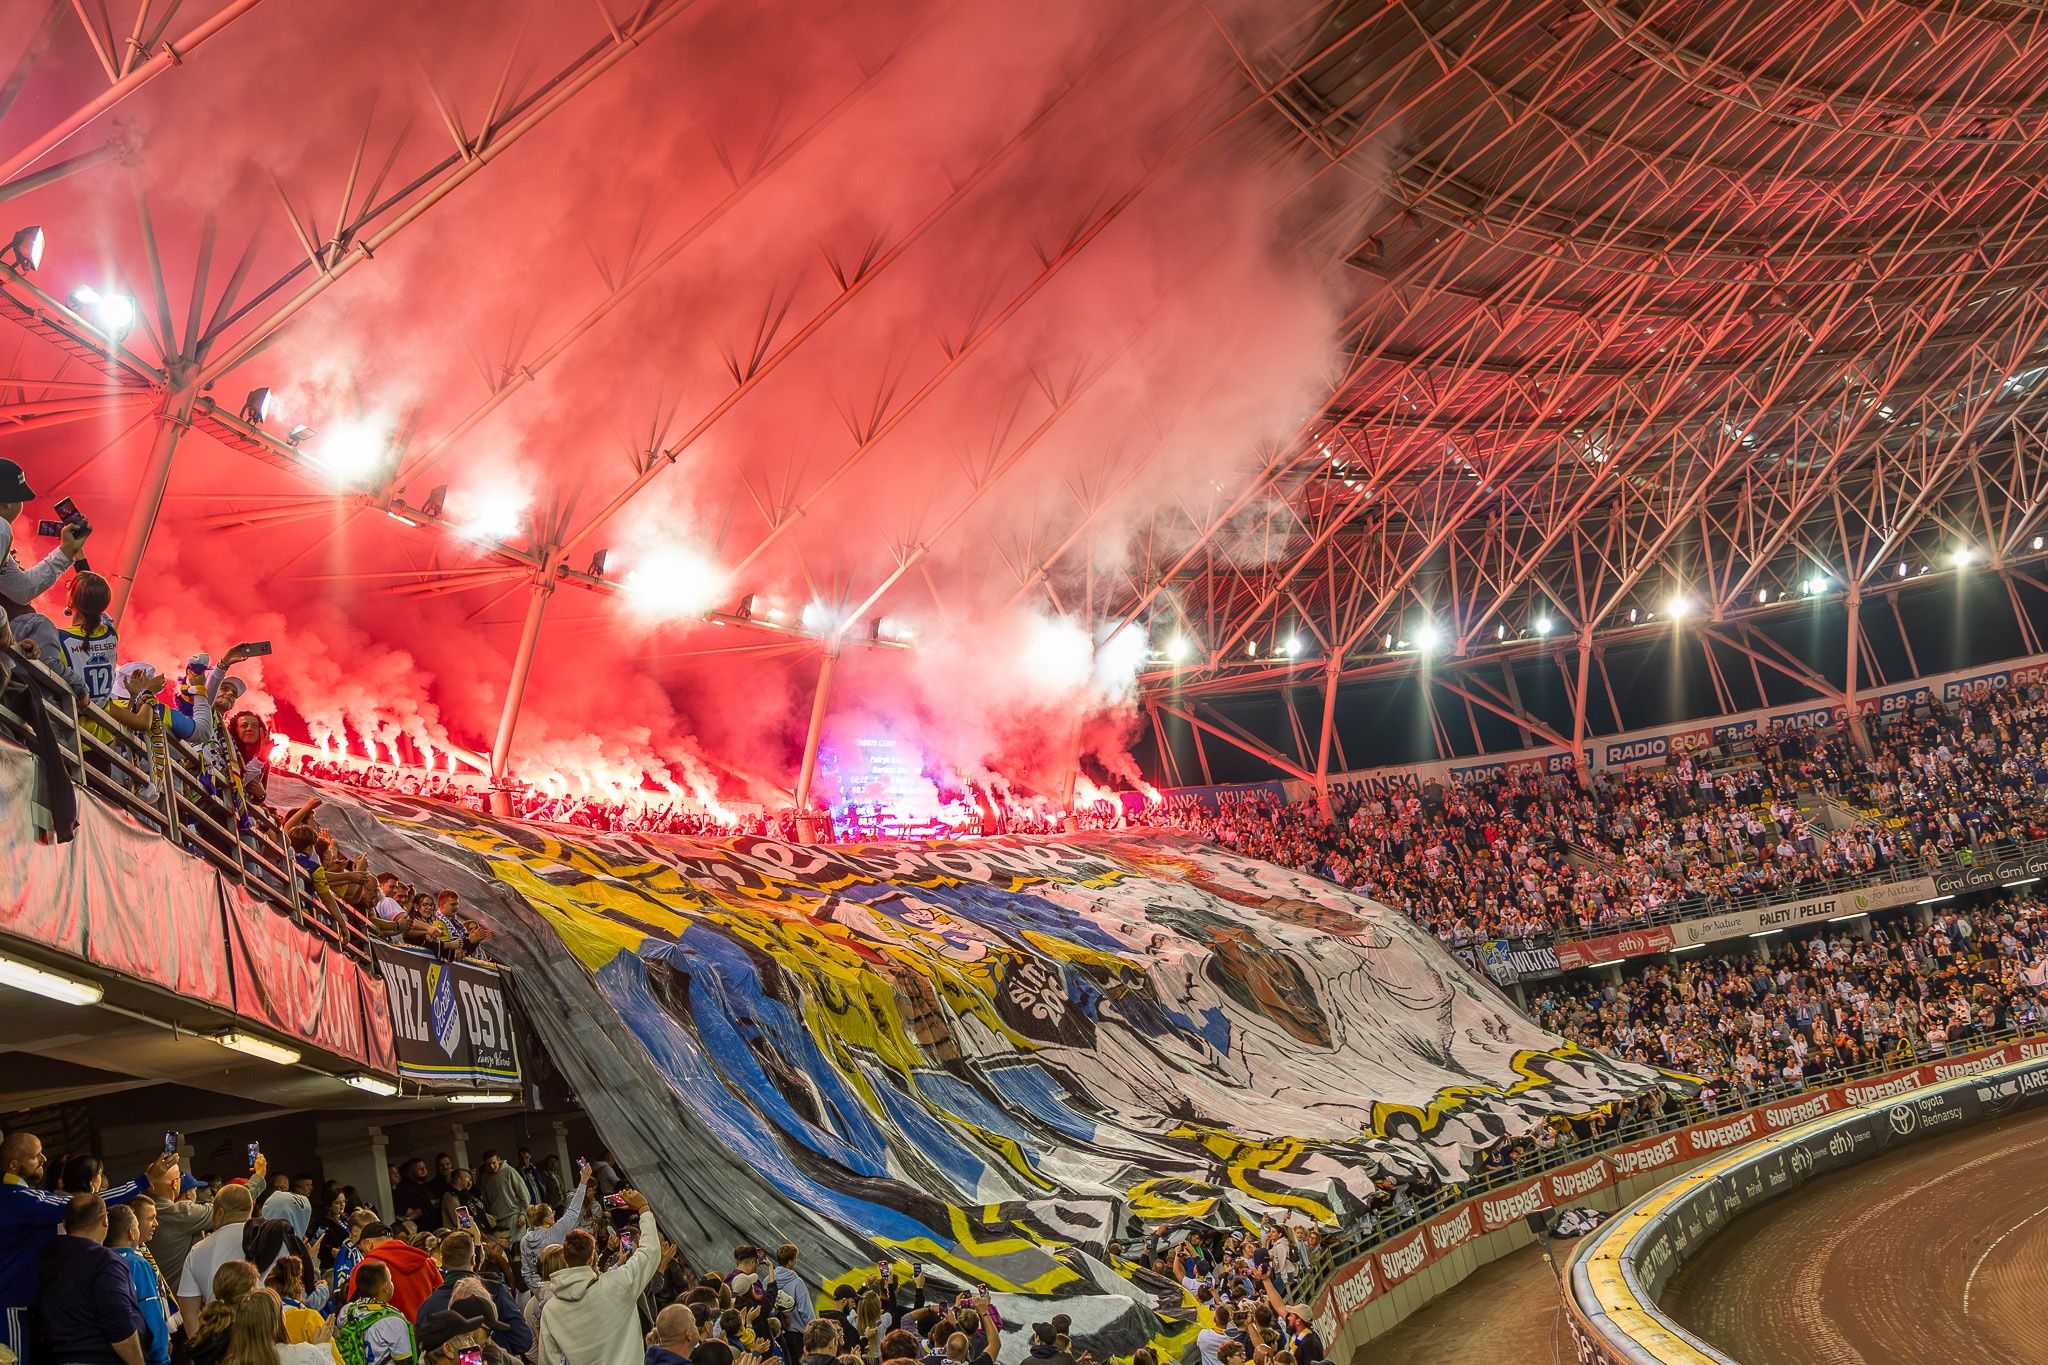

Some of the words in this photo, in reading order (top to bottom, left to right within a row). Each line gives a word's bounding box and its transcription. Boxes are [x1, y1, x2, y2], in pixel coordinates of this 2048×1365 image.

[71, 643, 117, 653] MIHELSEN
[90, 668, 109, 696] 12
[1833, 702, 1876, 722] GA
[1609, 739, 1667, 762] RADIO
[1311, 771, 1420, 800] TRMIŃSKI
[1760, 909, 1790, 926] PALETY
[1793, 907, 1798, 919] /
[1800, 900, 1837, 919] PELLET
[1618, 936, 1637, 951] eth
[1509, 946, 1559, 973] WOJTAS
[378, 959, 429, 1042] WRZ
[1935, 1051, 2007, 1082] SUPERBET
[1846, 1071, 1921, 1105] SUPERBET
[2018, 1069, 2048, 1094] JARE
[1767, 1094, 1830, 1127] SUPERBET
[1918, 1094, 1944, 1110] Toyota
[1922, 1106, 1963, 1128] Bednarscy
[1691, 1114, 1757, 1149] SUPERBET
[1829, 1132, 1848, 1156] eth
[1614, 1136, 1679, 1172] SUPERBET
[1552, 1158, 1607, 1197] SUPERBET
[1483, 1181, 1545, 1222] SUPERBET
[1431, 1207, 1471, 1249] SUPERBET
[1381, 1231, 1428, 1280] SUPERBET
